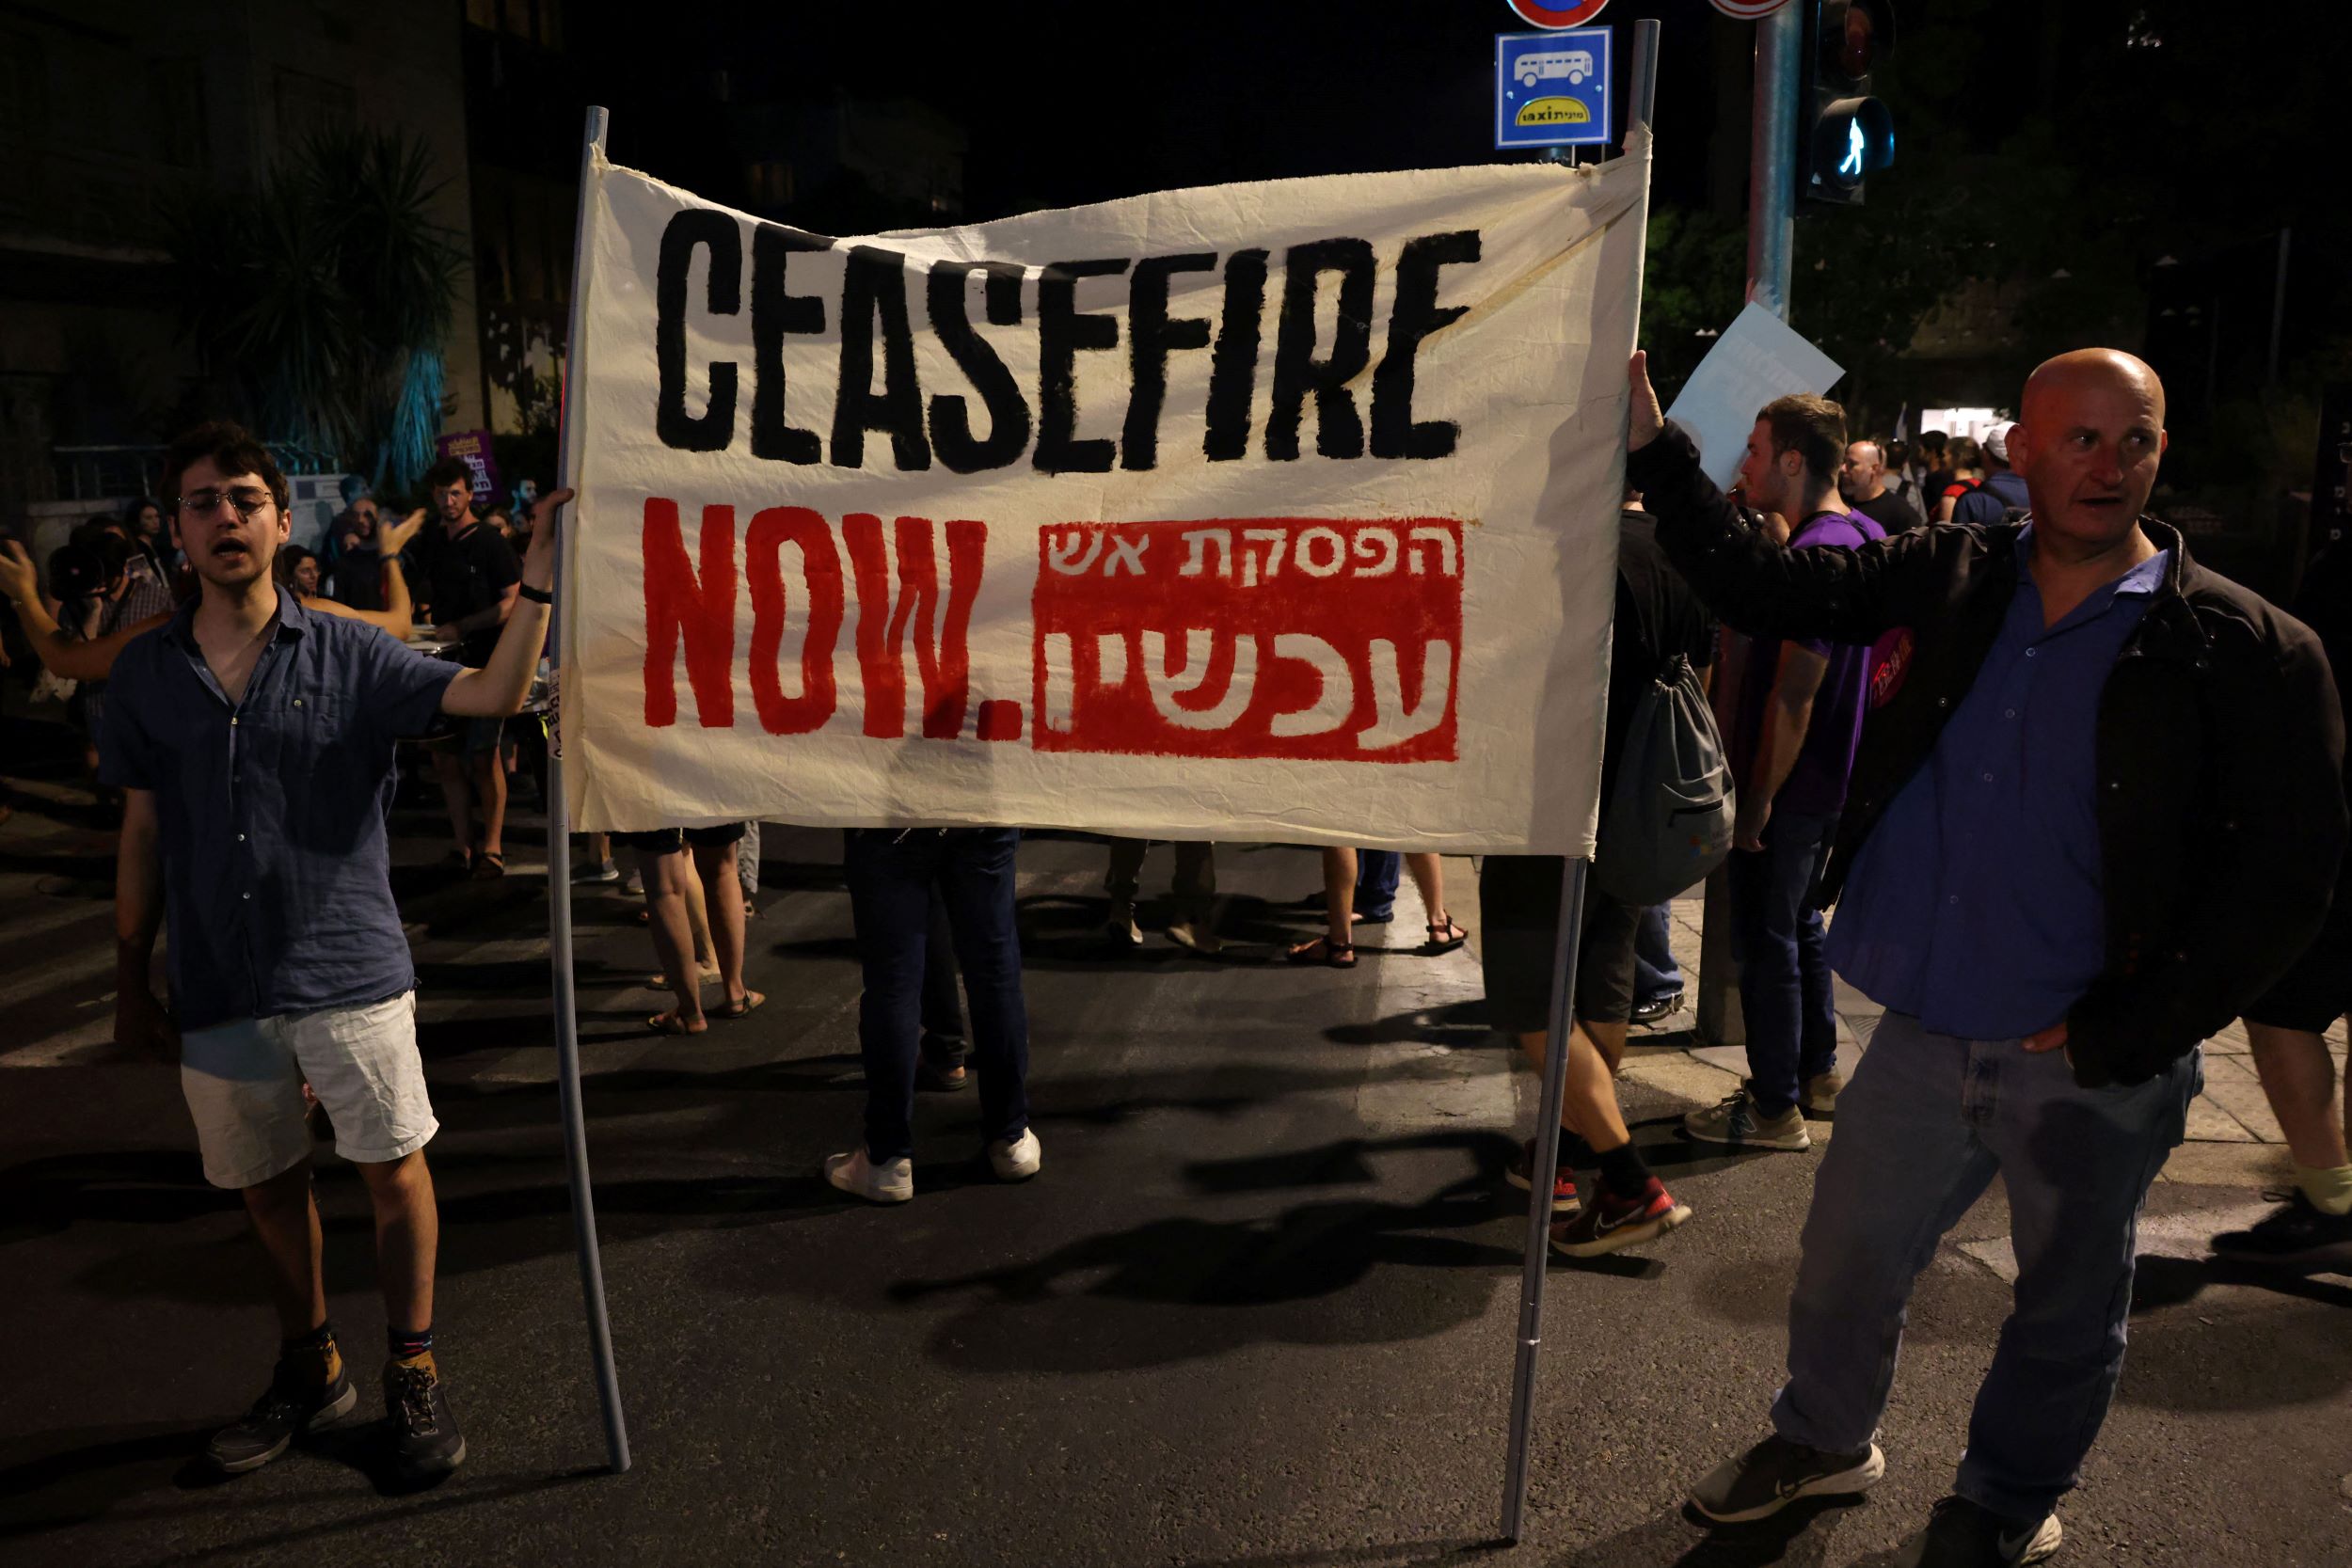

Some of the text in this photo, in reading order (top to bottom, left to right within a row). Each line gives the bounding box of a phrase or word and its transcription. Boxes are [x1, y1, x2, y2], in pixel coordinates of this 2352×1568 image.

[1554, 110, 1584, 120] מונית
[656, 209, 1481, 474] CEASEFIRE
[1048, 527, 1457, 587] הפסקת אש
[643, 497, 1023, 741] NOW.
[1044, 628, 1453, 751] עכשיו
